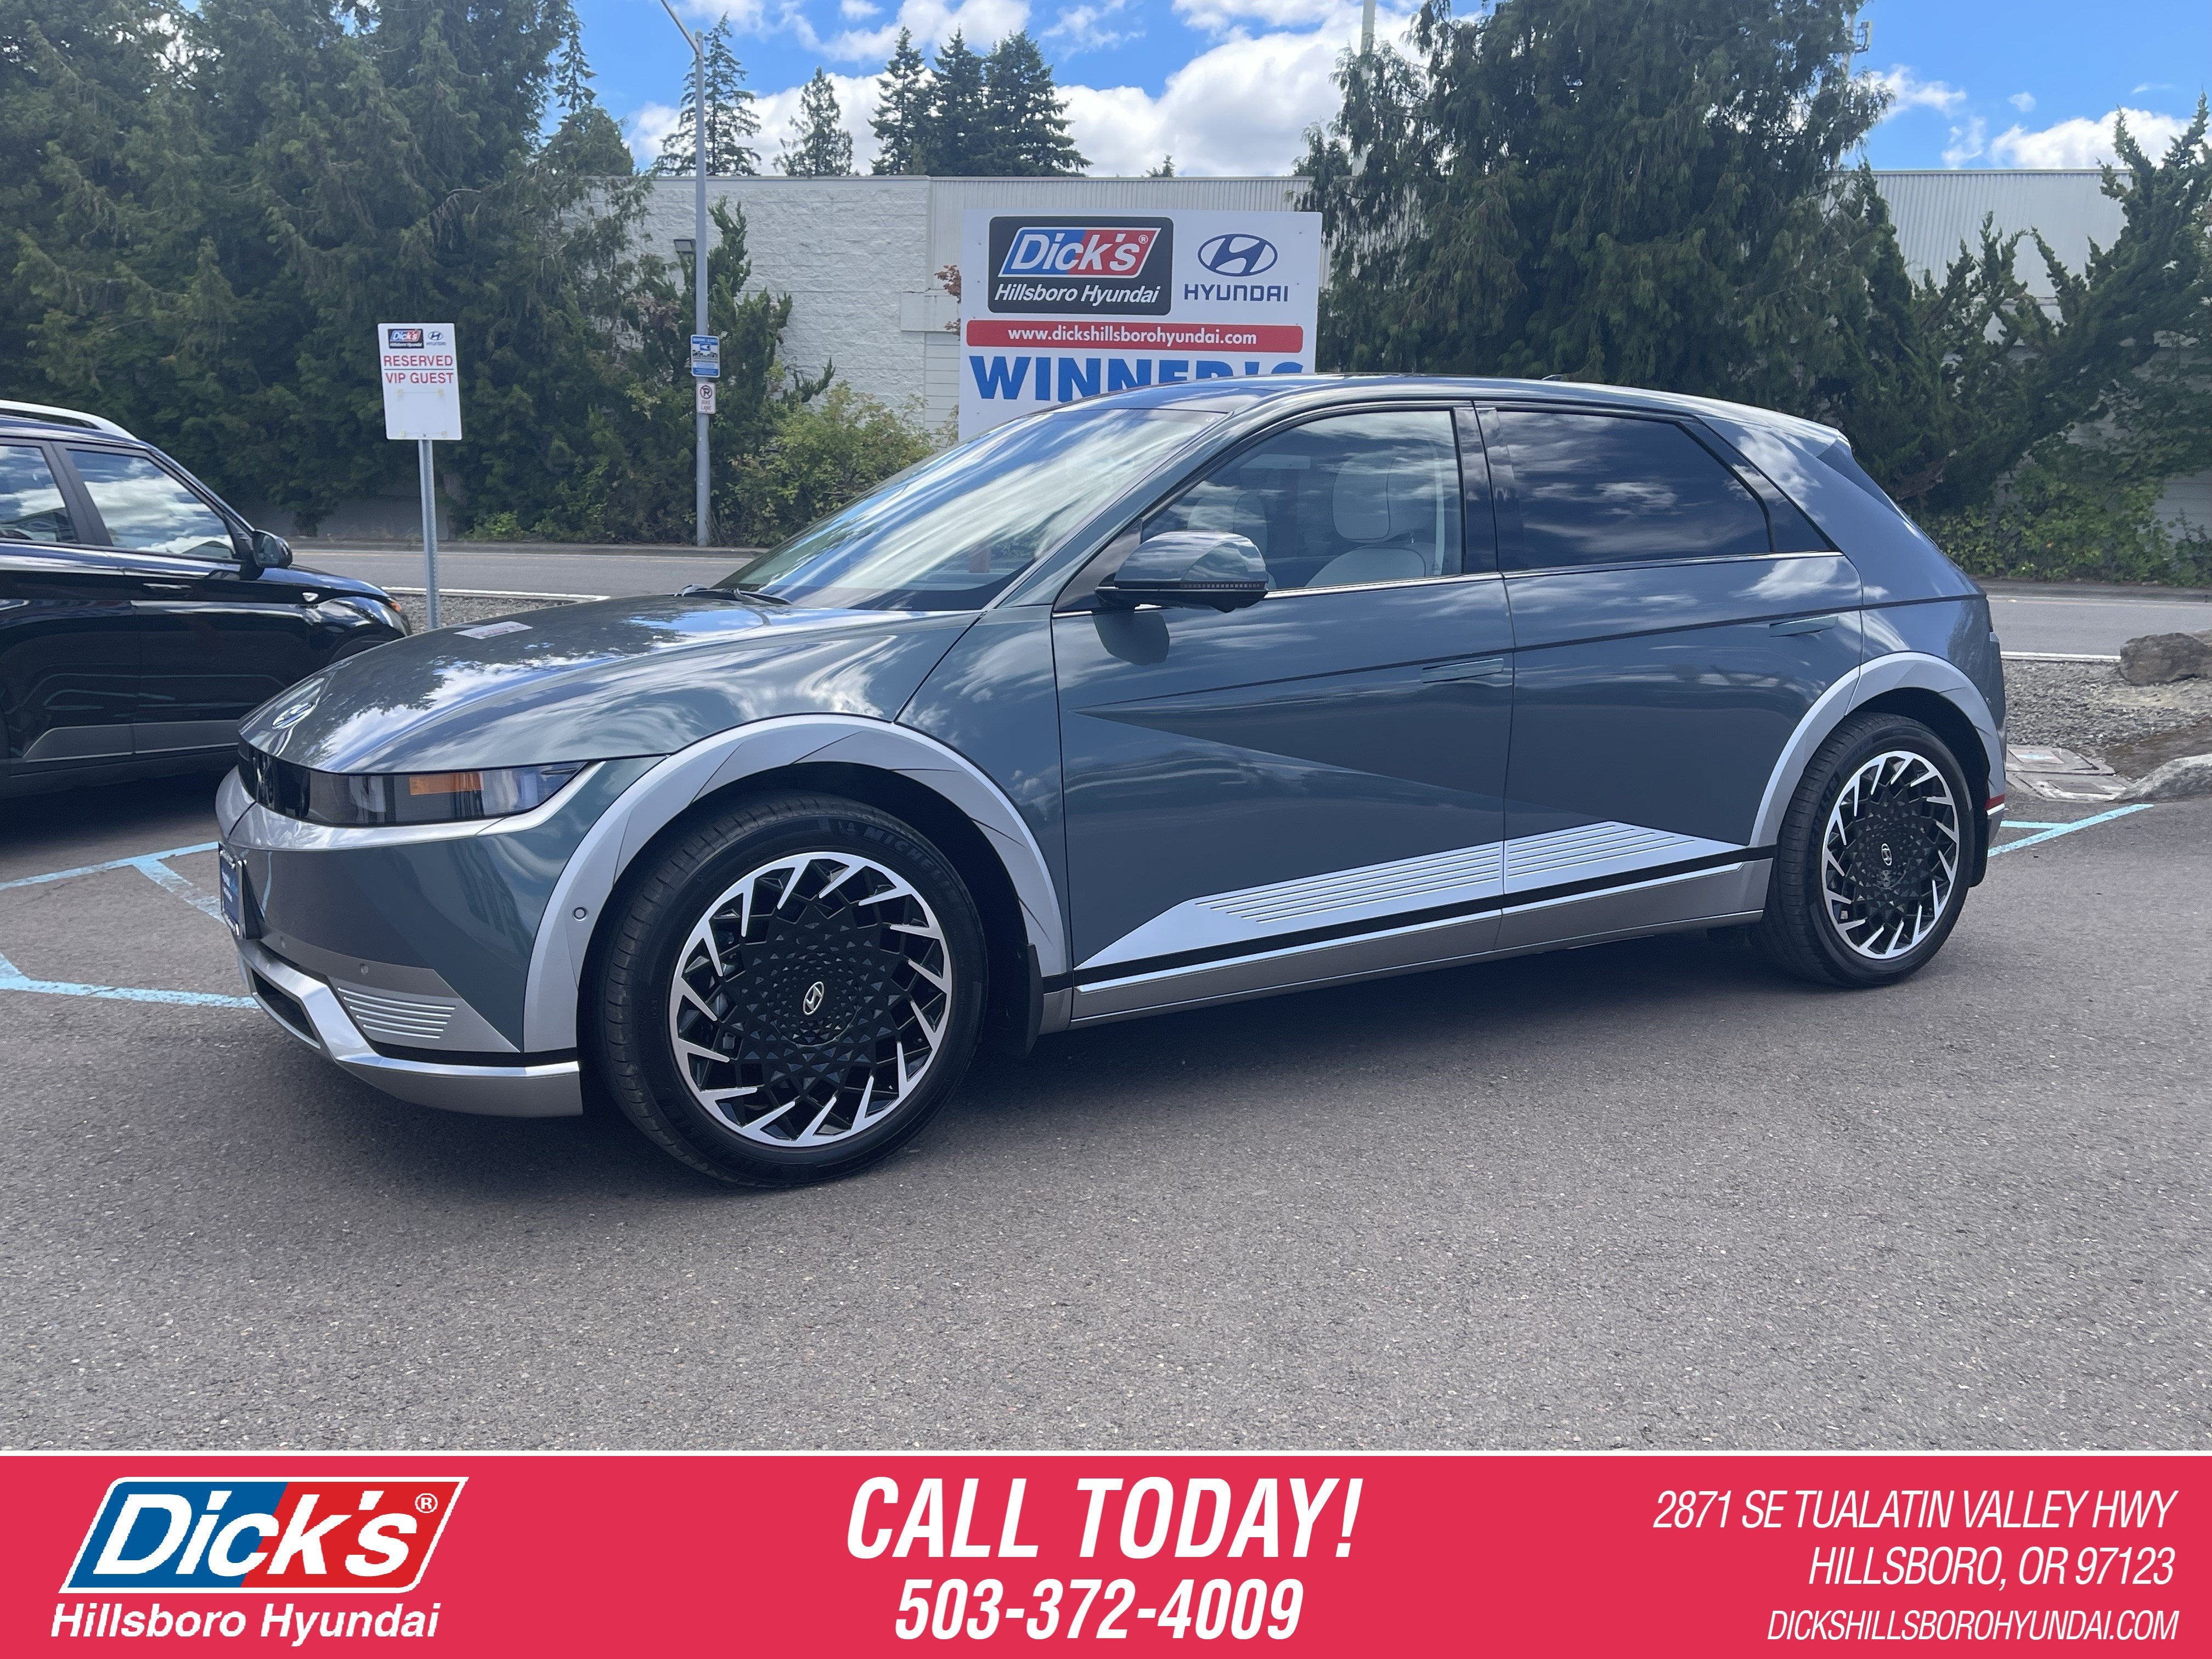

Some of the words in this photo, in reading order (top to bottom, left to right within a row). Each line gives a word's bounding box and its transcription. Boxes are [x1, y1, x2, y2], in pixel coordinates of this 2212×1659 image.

[1011, 232, 1140, 272] Dick's
[995, 283, 1077, 301] Hillsboro
[1081, 285, 1161, 307] Hyundai
[1184, 283, 1288, 302] HYUNDAI
[1008, 325, 1257, 348] www.dickshillsborohyundai.com
[383, 355, 453, 366] RESERVED
[385, 373, 406, 383] VIP
[410, 373, 454, 383] GUEST
[969, 355, 1304, 403] WINNE'
